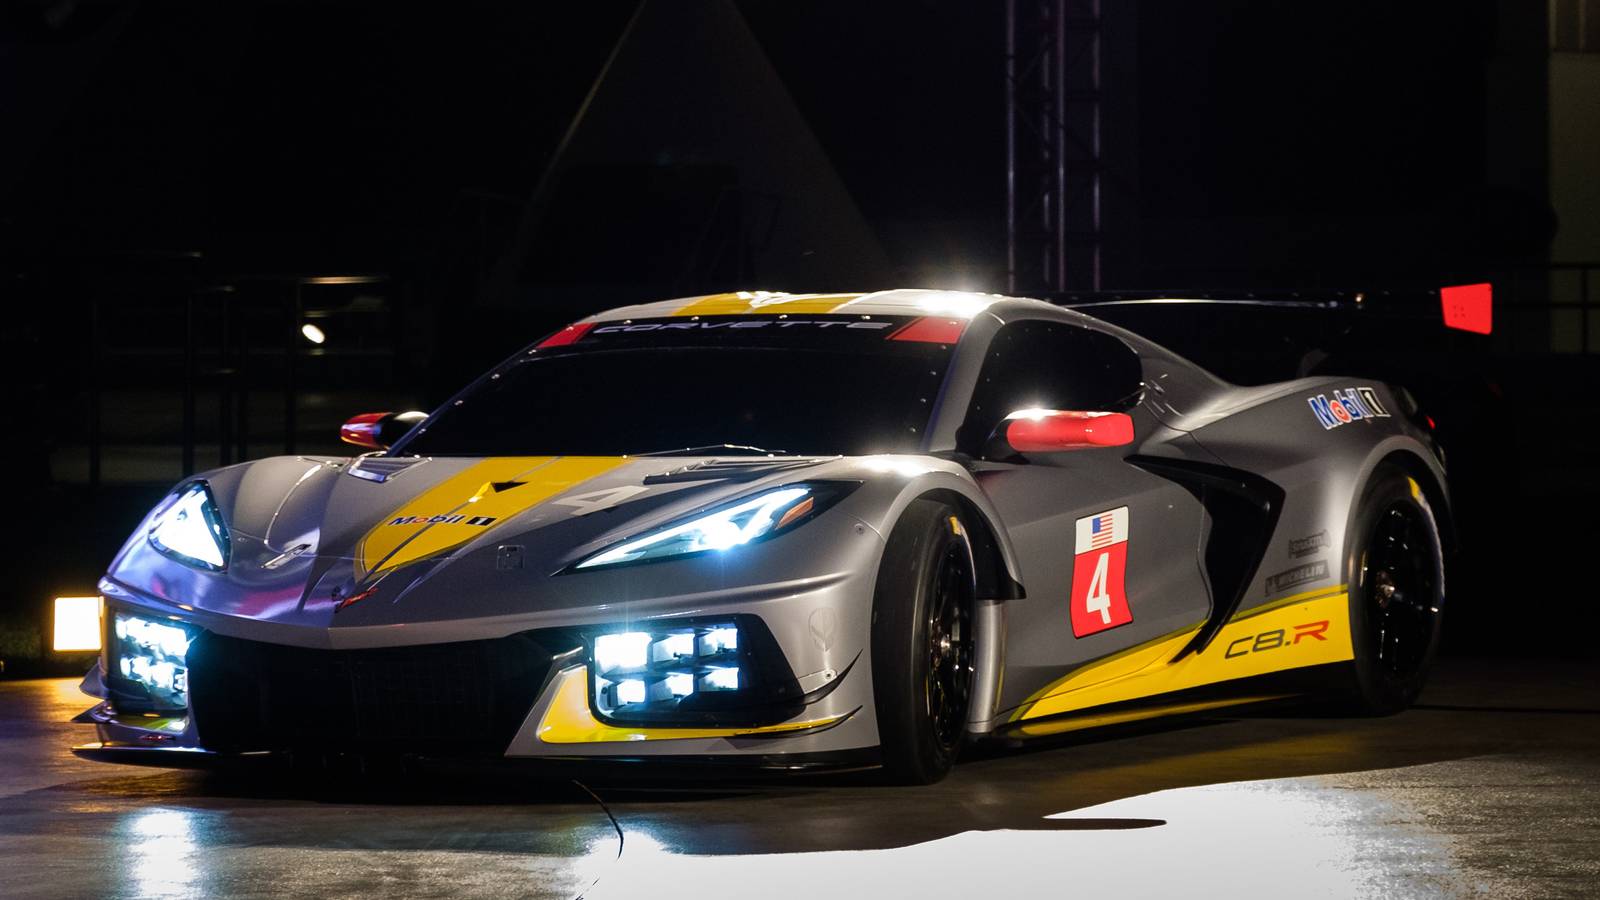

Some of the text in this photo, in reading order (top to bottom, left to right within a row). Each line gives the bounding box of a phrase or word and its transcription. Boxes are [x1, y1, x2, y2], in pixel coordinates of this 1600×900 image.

[593, 321, 893, 333] CORVETTE
[1307, 387, 1375, 430] Mobil
[552, 485, 650, 516] 4
[387, 515, 466, 525] Mobil
[1086, 552, 1111, 624] 4
[1224, 620, 1329, 659] C8.R
